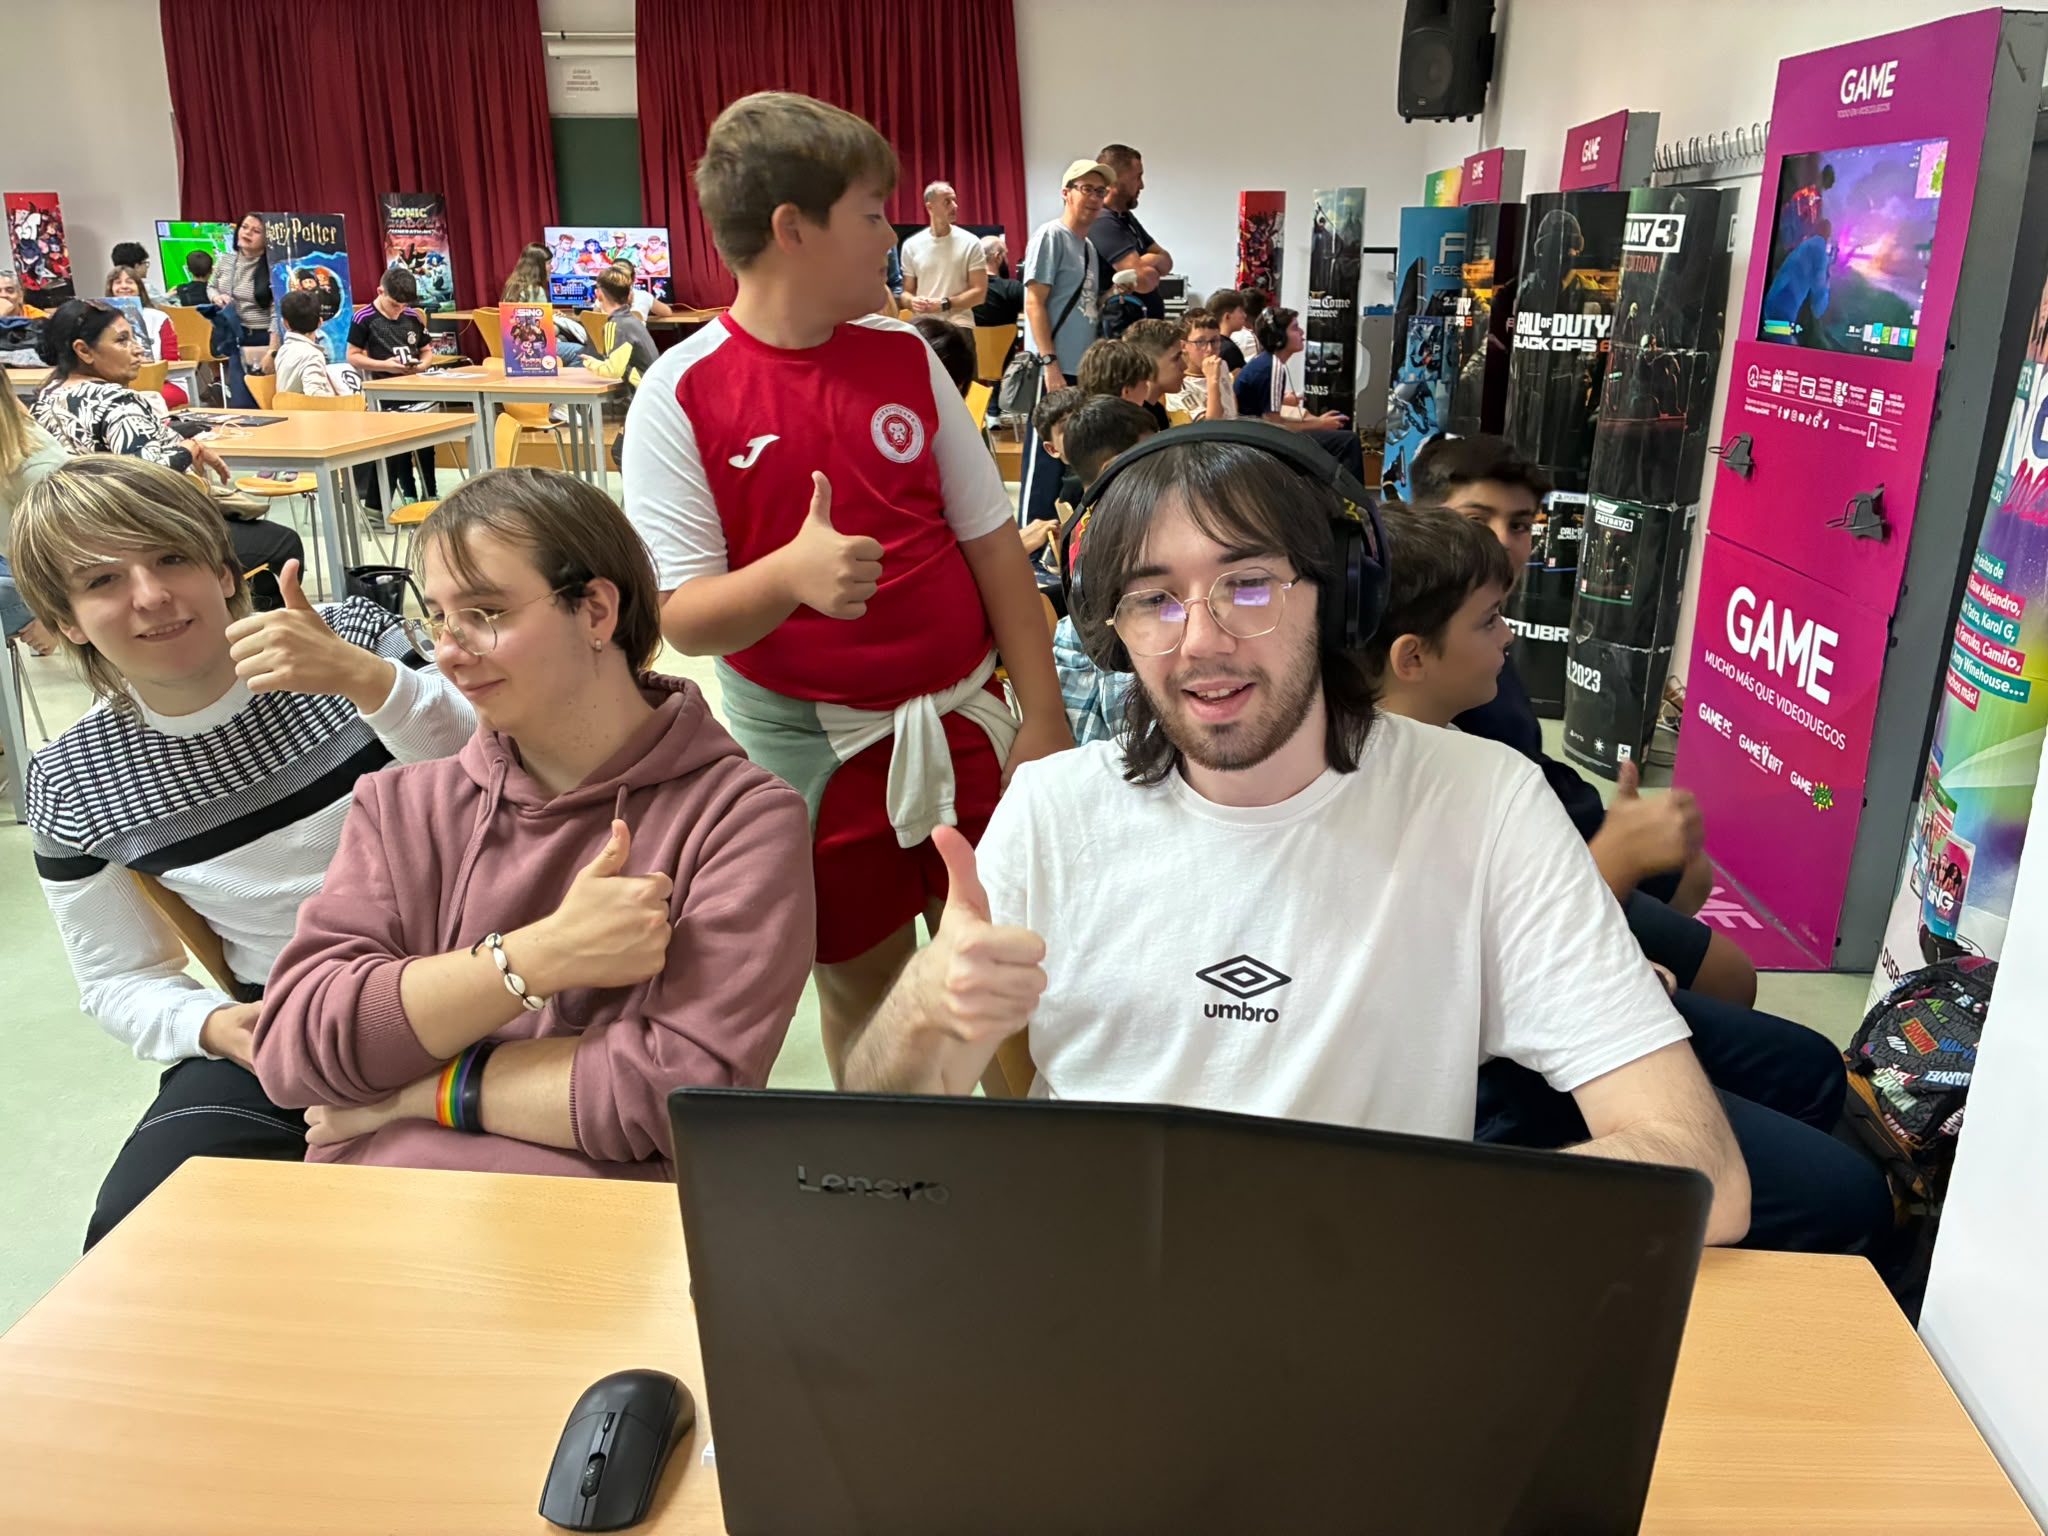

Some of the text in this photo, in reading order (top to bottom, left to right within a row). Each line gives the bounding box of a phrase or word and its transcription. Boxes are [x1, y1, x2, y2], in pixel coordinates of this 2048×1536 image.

[1840, 60, 1898, 104] GAME
[1582, 136, 1600, 163] GAME
[390, 207, 427, 218] SONIC
[291, 217, 336, 246] Potter
[1655, 219, 1680, 247] 3
[1322, 295, 1351, 309] Come
[1516, 312, 1611, 338] CALL OF DUTY
[1513, 335, 1551, 350] BLACK
[1552, 338, 1597, 352] OPS
[1993, 562, 2004, 579] de
[1980, 583, 2021, 616] Alejandro,
[1981, 612, 2003, 635] Karol
[2004, 624, 2015, 643] G,
[1727, 586, 1839, 706] GAME
[1982, 641, 2022, 672] Camilo,
[1705, 649, 1846, 750] MUCHO MÁS QUE VIDEOJUEGOS
[1960, 687, 1978, 705] más!
[1699, 702, 1733, 734] GAME PC
[1739, 733, 1762, 761] GAME
[1767, 753, 1783, 775] GIFT
[1790, 771, 1812, 796] GAME
[1204, 1001, 1279, 1023] umbro
